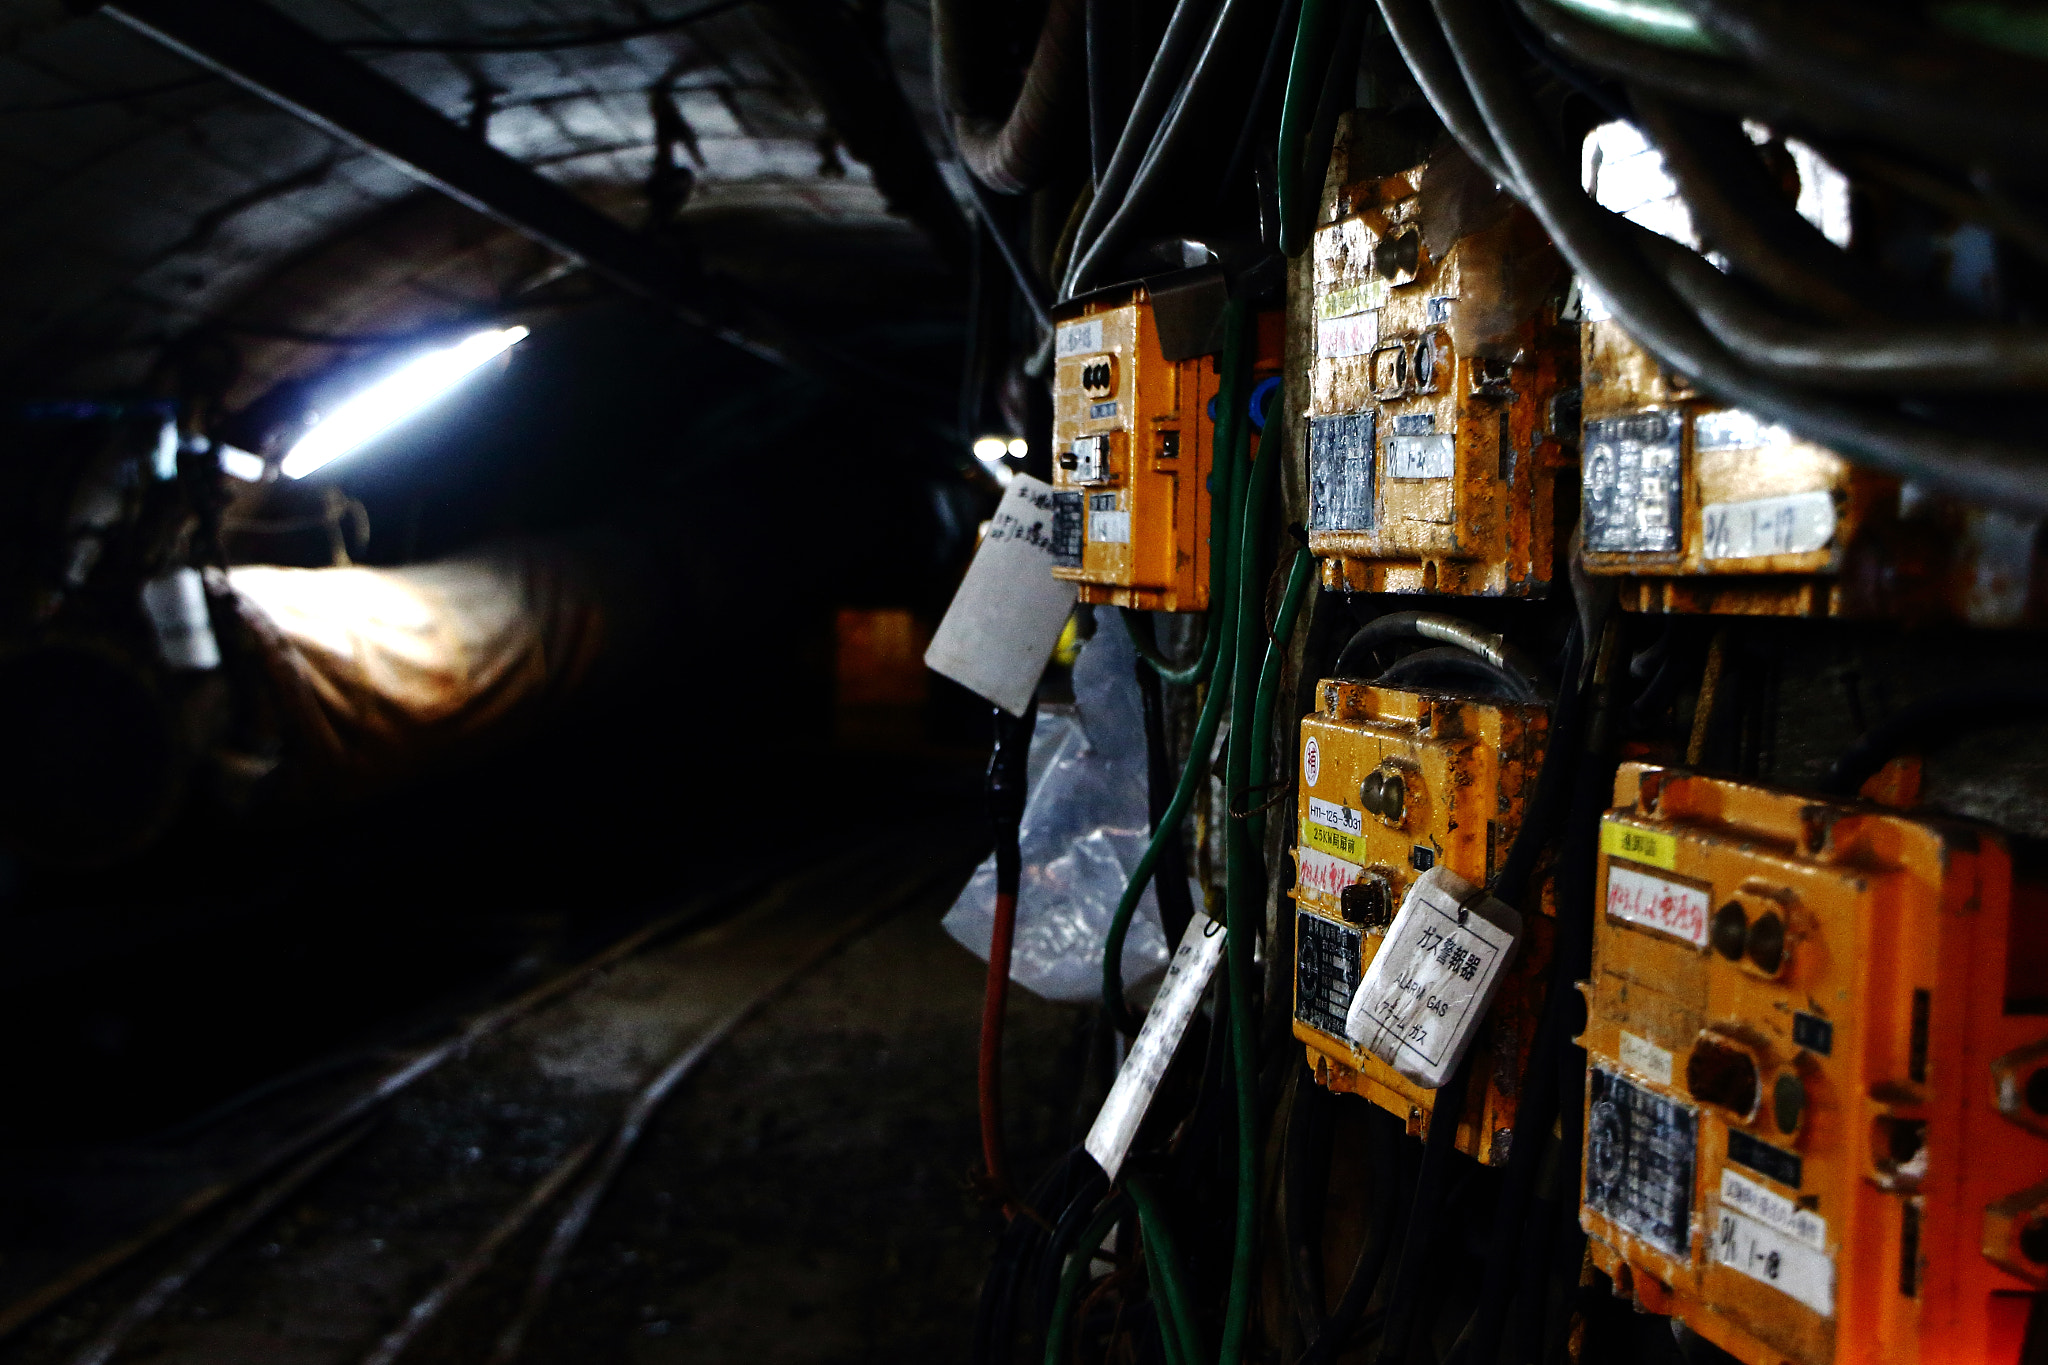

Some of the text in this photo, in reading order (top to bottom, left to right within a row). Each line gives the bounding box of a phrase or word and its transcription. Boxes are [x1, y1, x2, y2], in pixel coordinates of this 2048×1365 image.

[1416, 926, 1481, 981] ガス警報器
[1393, 972, 1449, 1018] ALARM GAS
